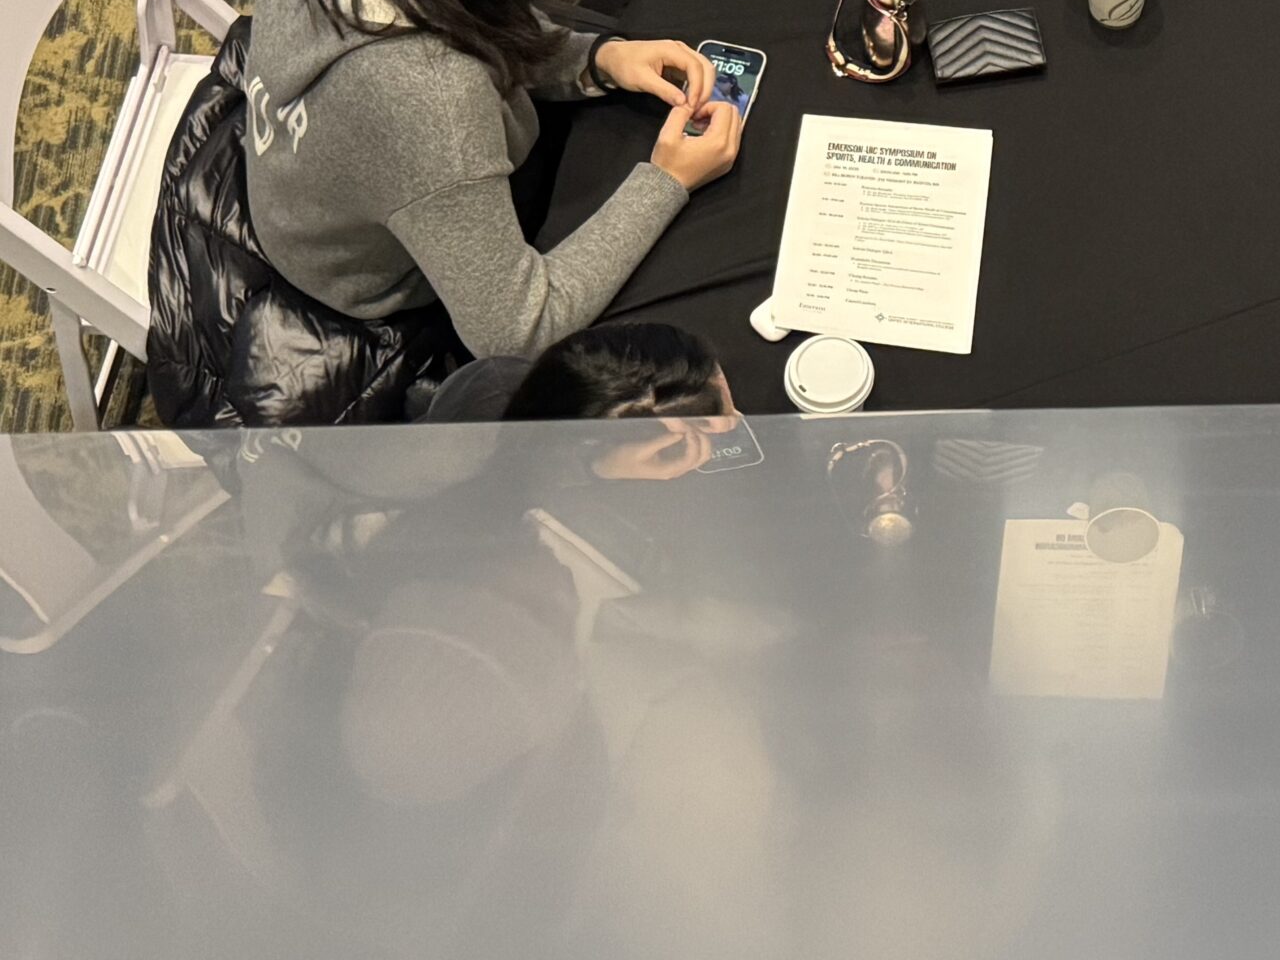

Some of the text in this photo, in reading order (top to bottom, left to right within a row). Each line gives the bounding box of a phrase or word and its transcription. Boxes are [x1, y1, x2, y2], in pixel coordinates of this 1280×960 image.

[711, 59, 745, 76] 11:09
[879, 147, 925, 159] SYMPOSIUM
[926, 151, 937, 160] ON
[857, 155, 886, 166] HEALTH
[894, 158, 957, 171] COMMUNICATION
